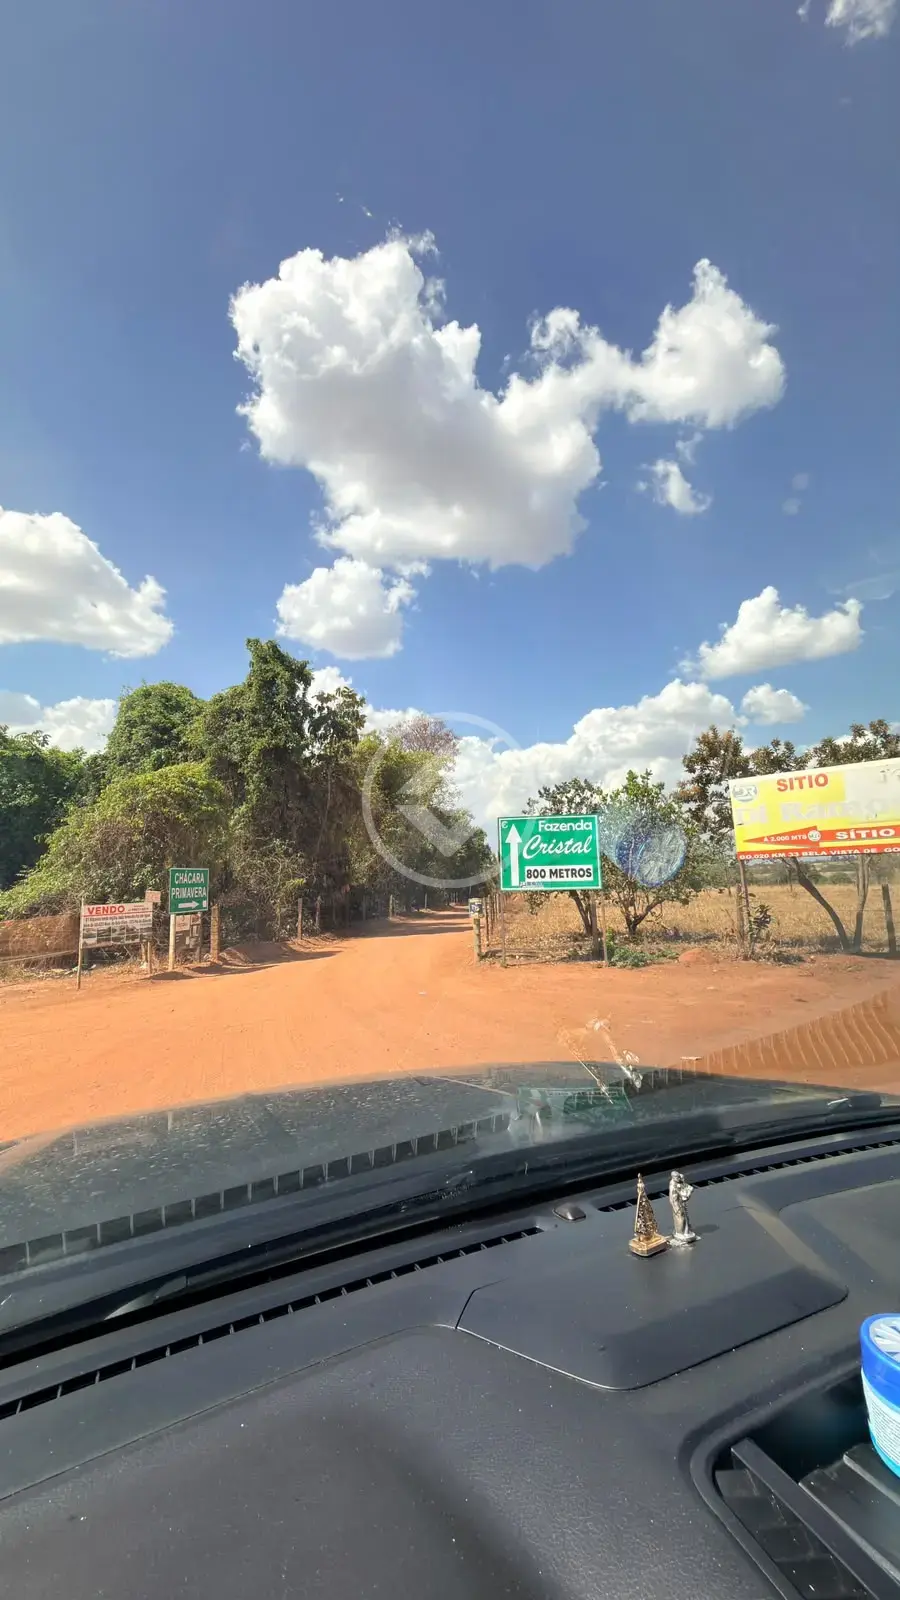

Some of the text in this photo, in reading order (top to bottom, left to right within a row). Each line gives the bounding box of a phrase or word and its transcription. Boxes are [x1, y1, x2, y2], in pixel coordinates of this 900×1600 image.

[777, 773, 829, 792] SITIO
[538, 820, 593, 832] Fazenda
[835, 828, 896, 840] SÍTIO
[522, 834, 593, 859] Cristal
[174, 870, 205, 885] CHÁCARA
[526, 867, 592, 879] 800 METROS
[171, 886, 207, 899] PRIMAVERA
[87, 905, 126, 915] VENDO
